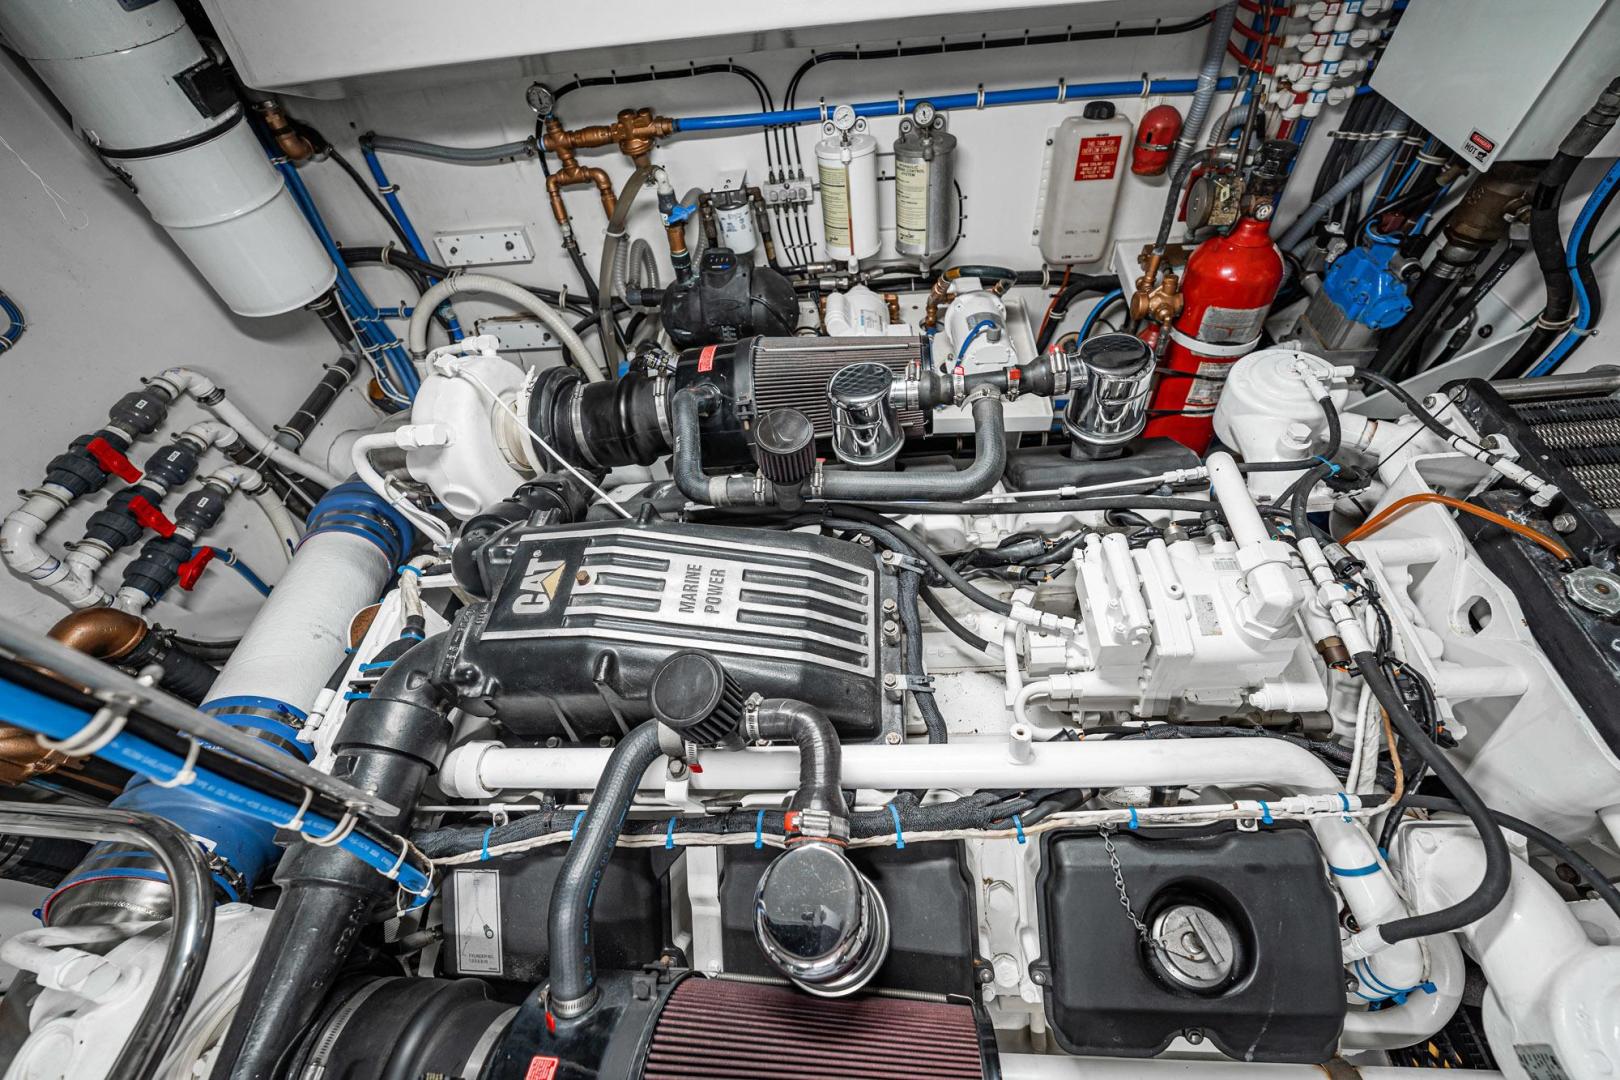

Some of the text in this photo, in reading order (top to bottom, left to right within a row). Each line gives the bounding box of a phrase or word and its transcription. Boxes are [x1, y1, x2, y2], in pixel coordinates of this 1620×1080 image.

[1464, 141, 1478, 155] HOT
[512, 557, 566, 614] CAT
[679, 564, 702, 613] MARINE
[704, 569, 726, 614] POWER
